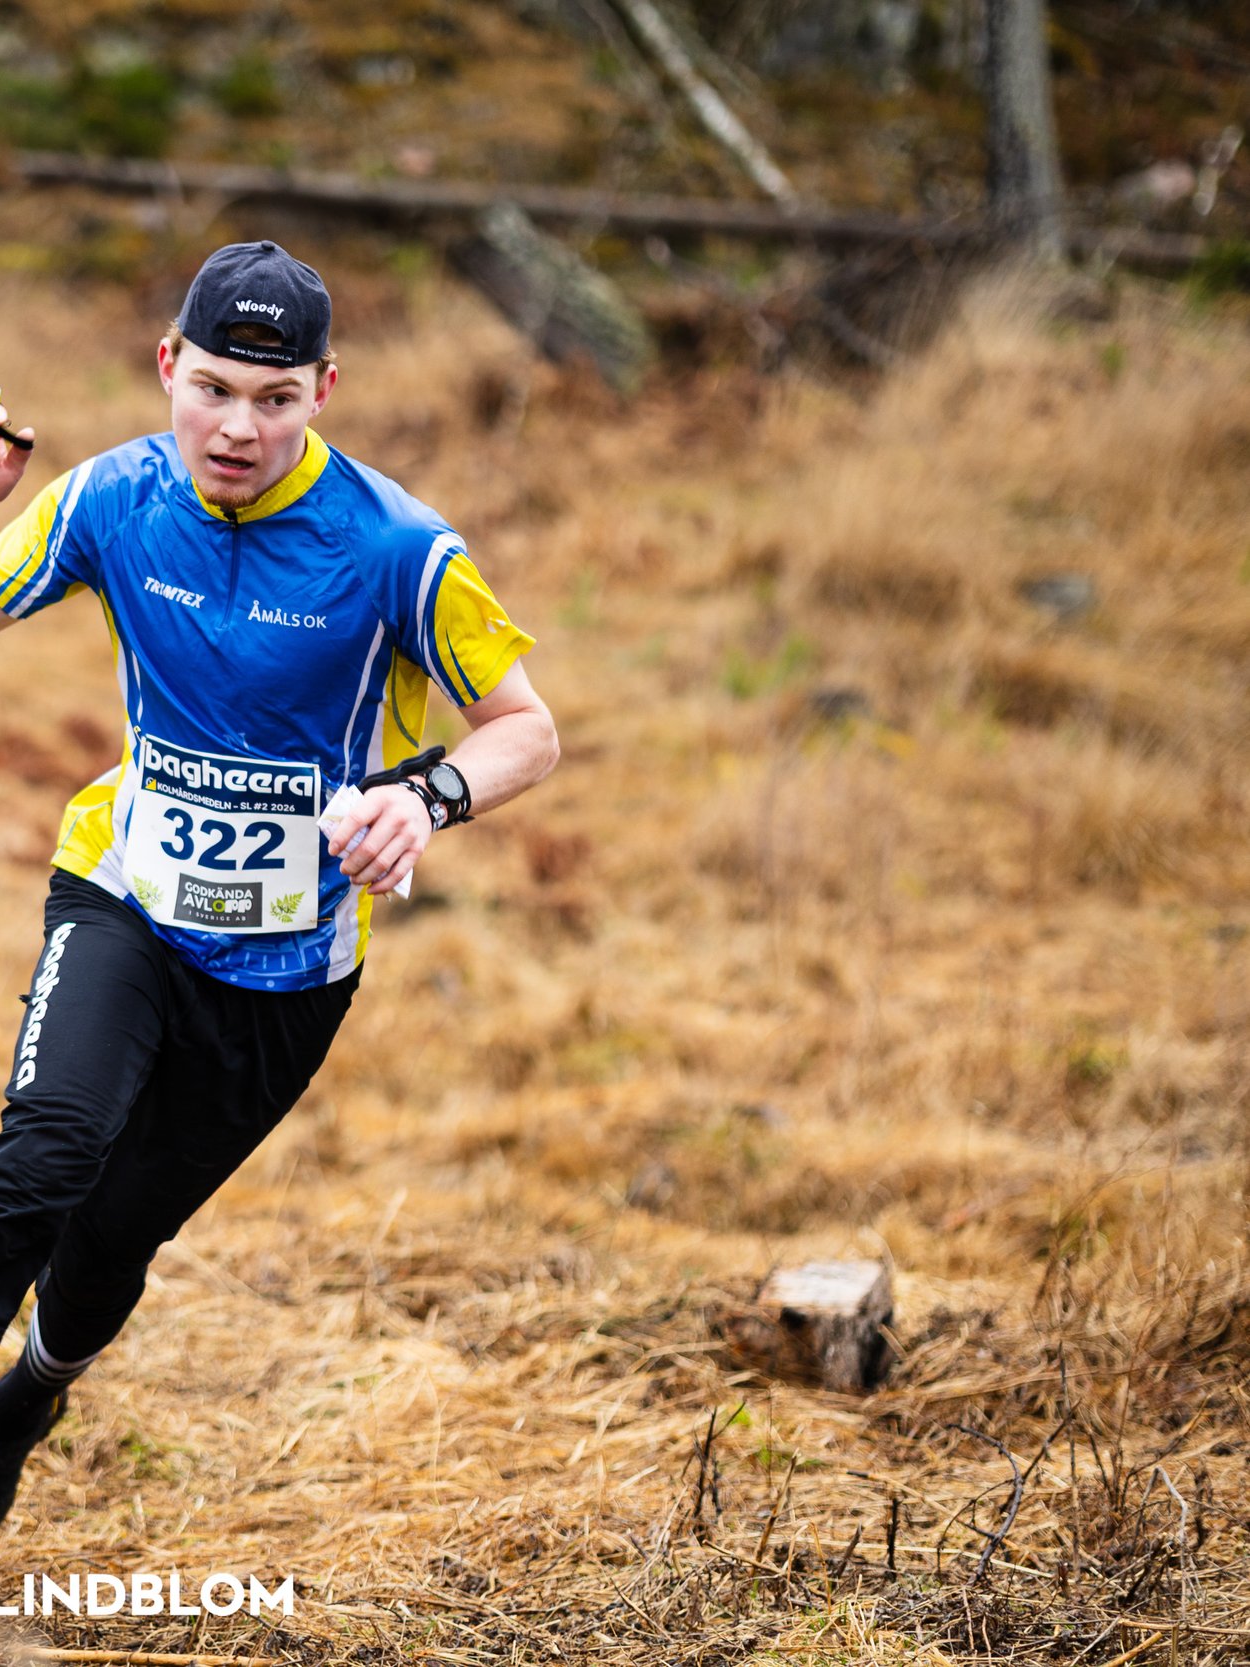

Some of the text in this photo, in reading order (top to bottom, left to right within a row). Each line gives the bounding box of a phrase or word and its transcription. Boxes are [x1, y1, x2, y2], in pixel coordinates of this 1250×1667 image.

[235, 299, 285, 321] Woody
[143, 576, 206, 609] TRIMTEX
[248, 600, 327, 629] ÅMÅLS OK
[144, 741, 314, 797] bagheera
[157, 782, 232, 810] KOLMÅRDSMEDELN
[240, 803, 252, 811] SL
[254, 803, 268, 811] #2
[271, 804, 296, 812] 2026
[160, 807, 286, 871] 322
[184, 881, 254, 899] GODKÄNDA
[196, 912, 231, 921] SVERIGE
